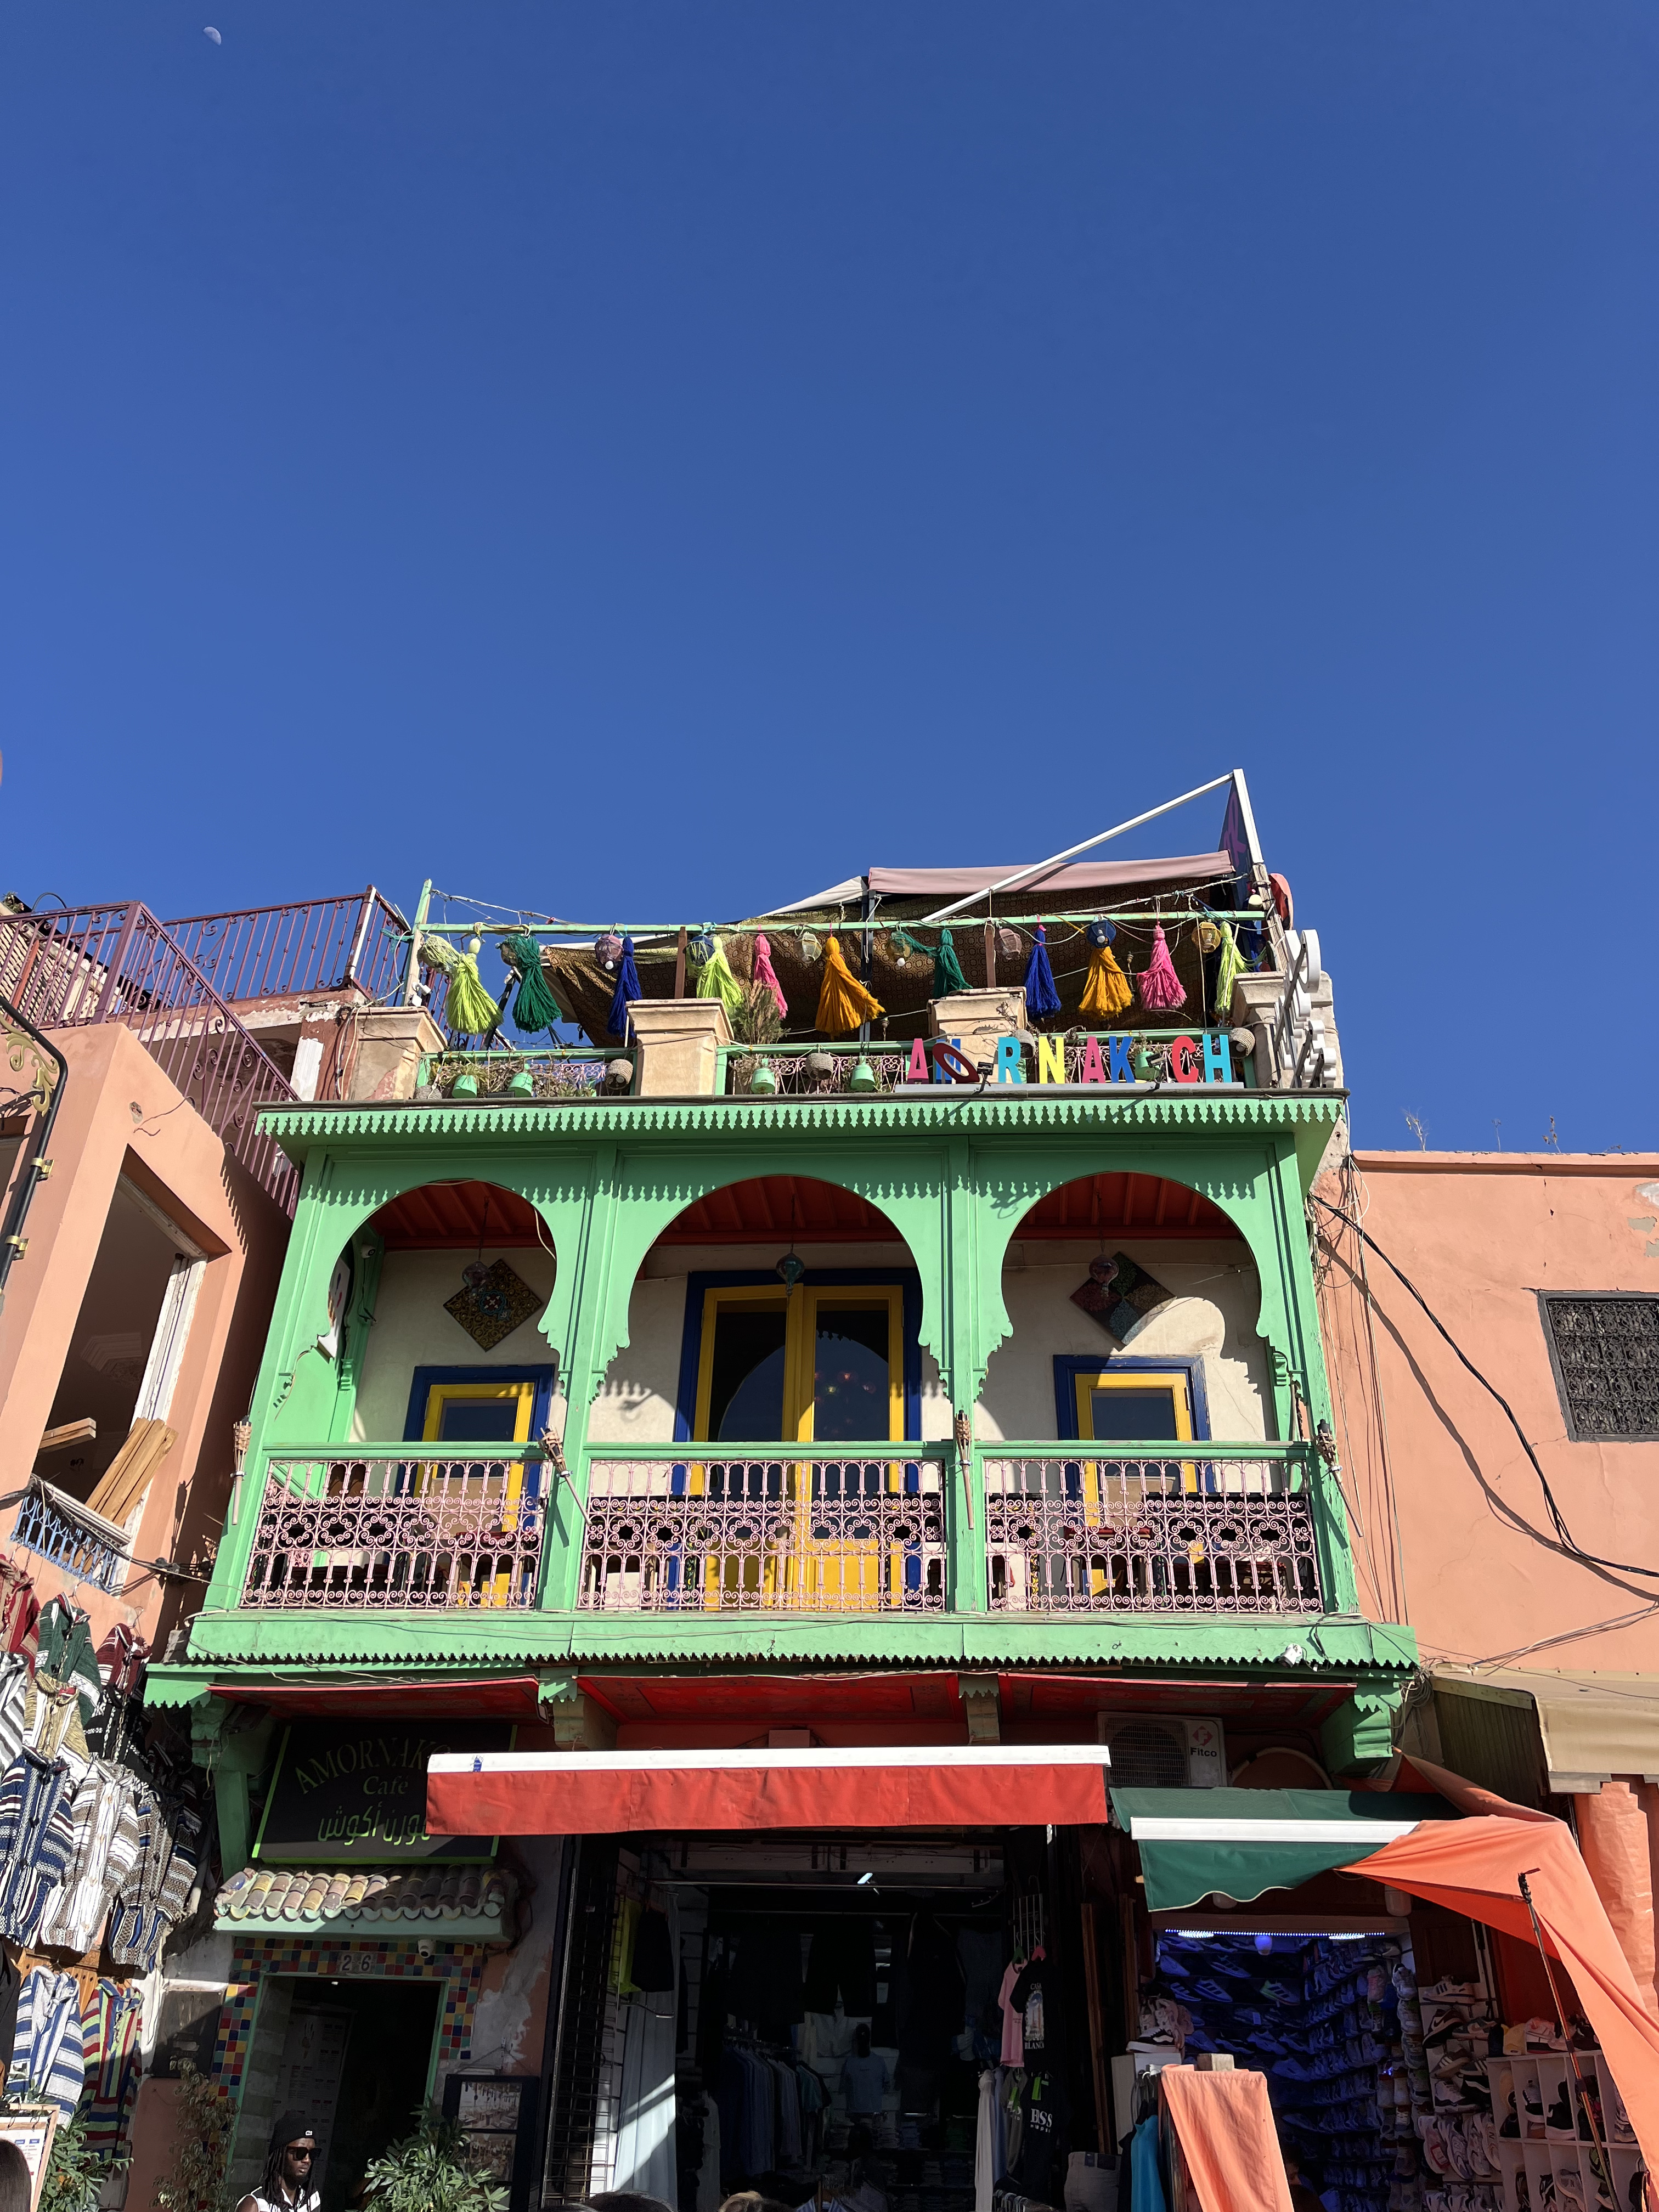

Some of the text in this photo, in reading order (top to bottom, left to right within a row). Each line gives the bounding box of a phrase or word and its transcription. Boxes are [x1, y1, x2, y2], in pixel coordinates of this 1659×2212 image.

[1190, 1747, 1217, 1757] Fitco
[295, 1737, 452, 1795] AMORNAK
[363, 1775, 409, 1795] Café
[342, 1954, 371, 1971] 26
